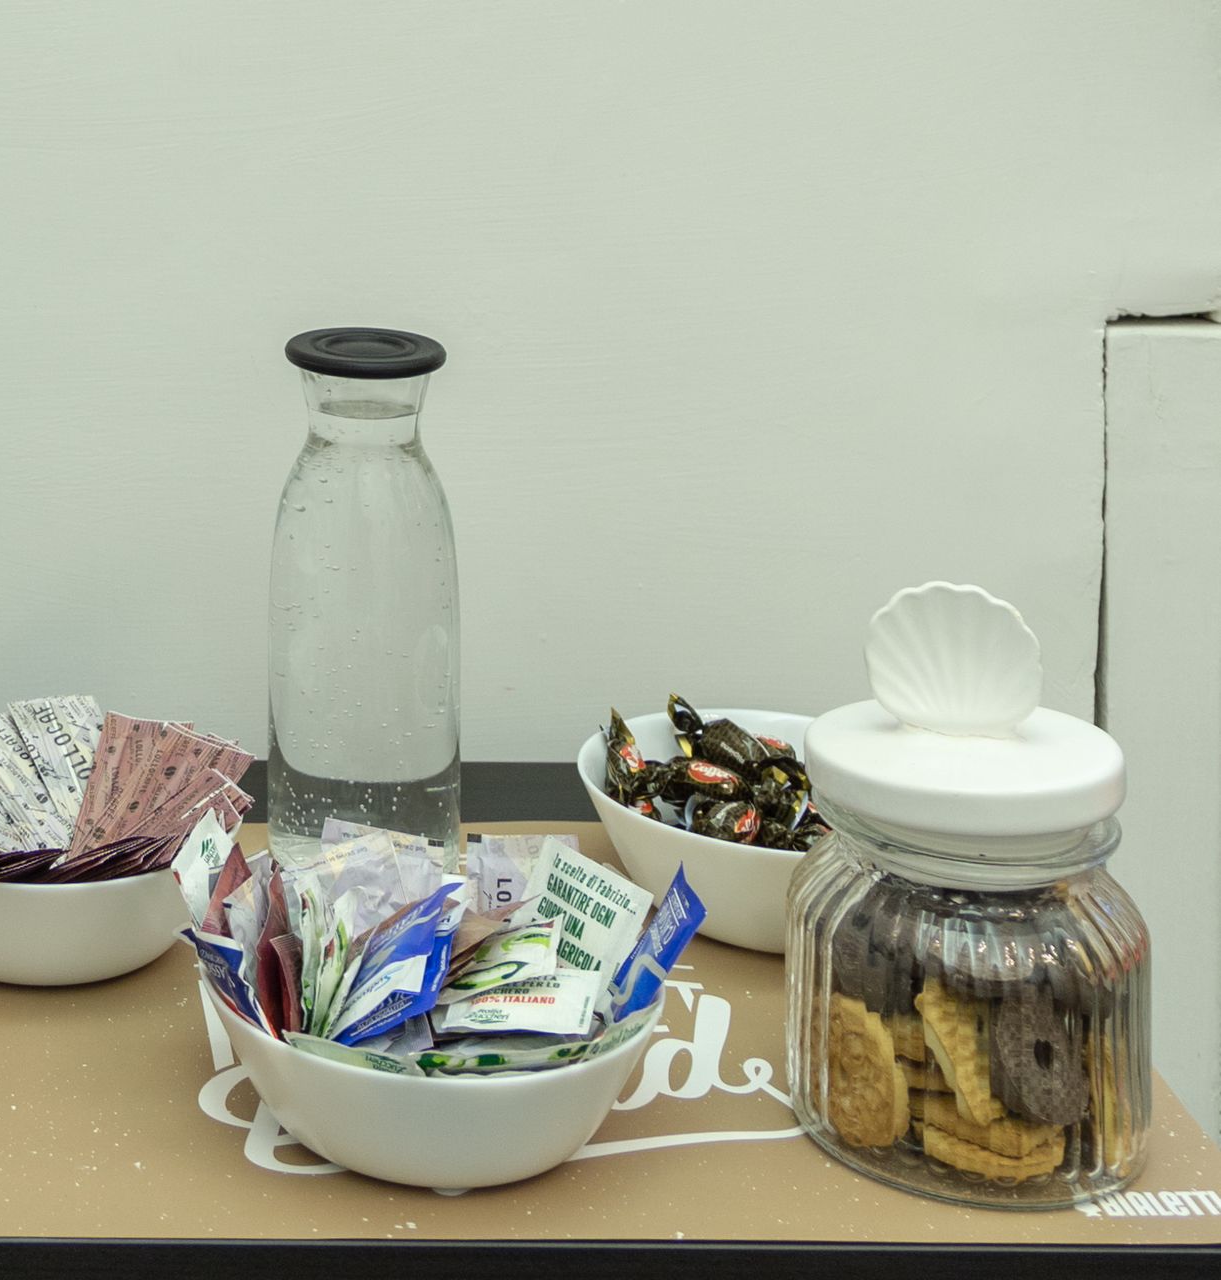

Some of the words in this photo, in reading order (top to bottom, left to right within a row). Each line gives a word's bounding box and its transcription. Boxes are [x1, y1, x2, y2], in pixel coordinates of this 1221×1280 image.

[560, 861, 587, 884] scelta
[546, 873, 594, 916] GARANTIRE
[590, 901, 617, 929] OGNI
[564, 914, 585, 941] UNA
[503, 995, 556, 1004] ITALIANO
